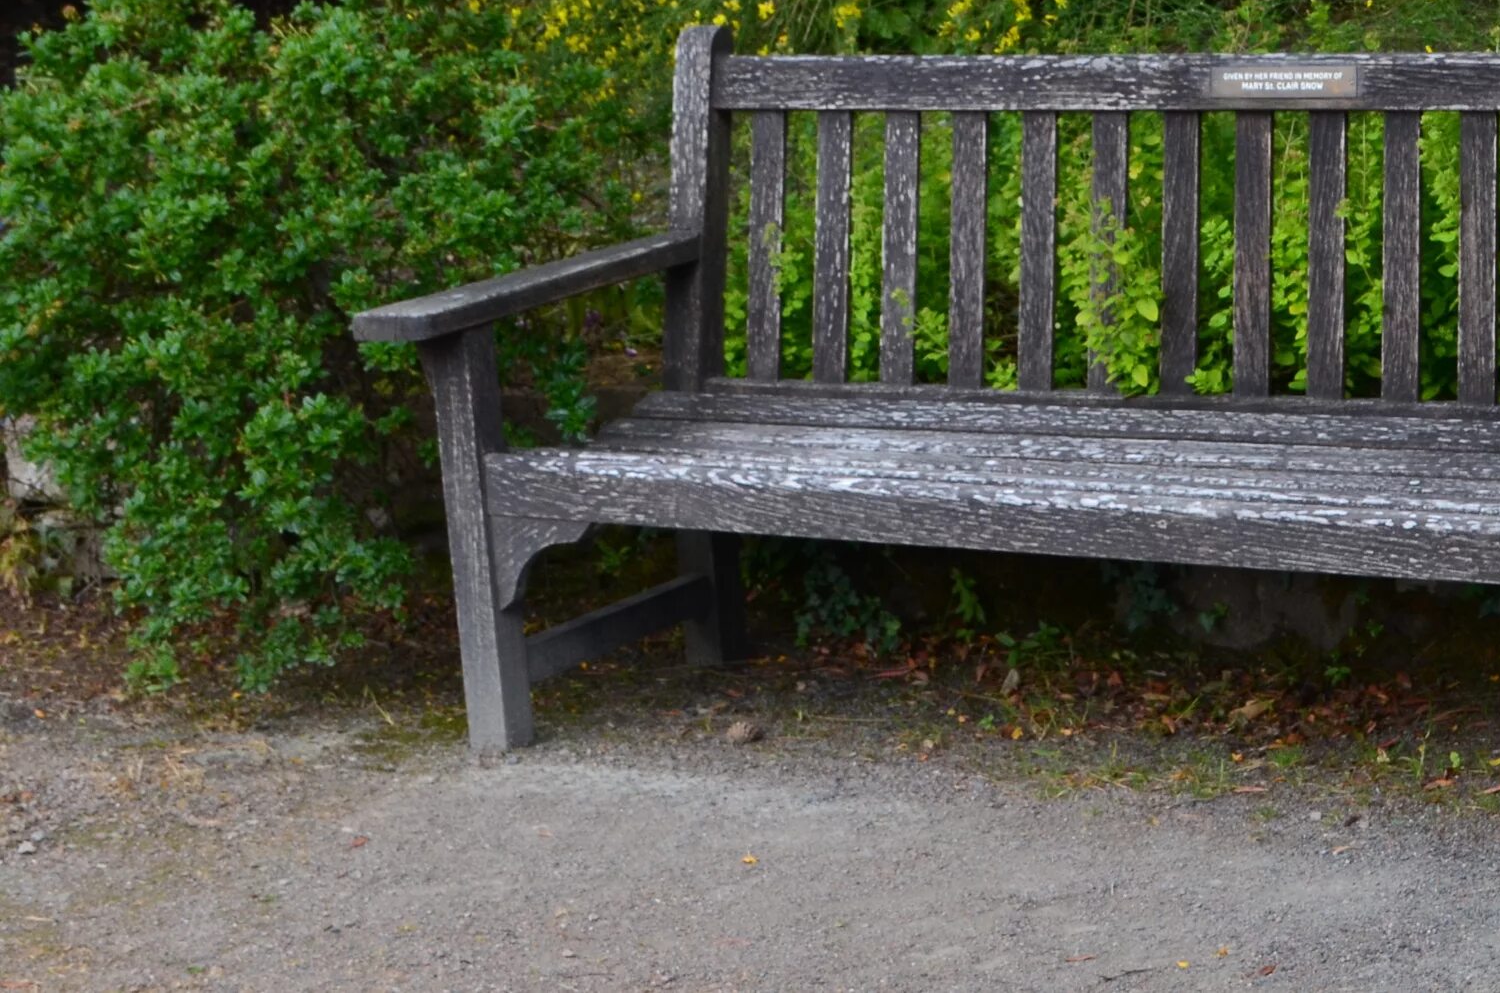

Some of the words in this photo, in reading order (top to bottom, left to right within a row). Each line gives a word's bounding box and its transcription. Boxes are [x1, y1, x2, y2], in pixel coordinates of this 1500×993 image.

[1294, 72, 1302, 80] IN
[1303, 72, 1333, 80] MEMORY
[1333, 72, 1343, 80] OF
[1241, 82, 1264, 90] MARY
[1276, 82, 1299, 90] CLAIR
